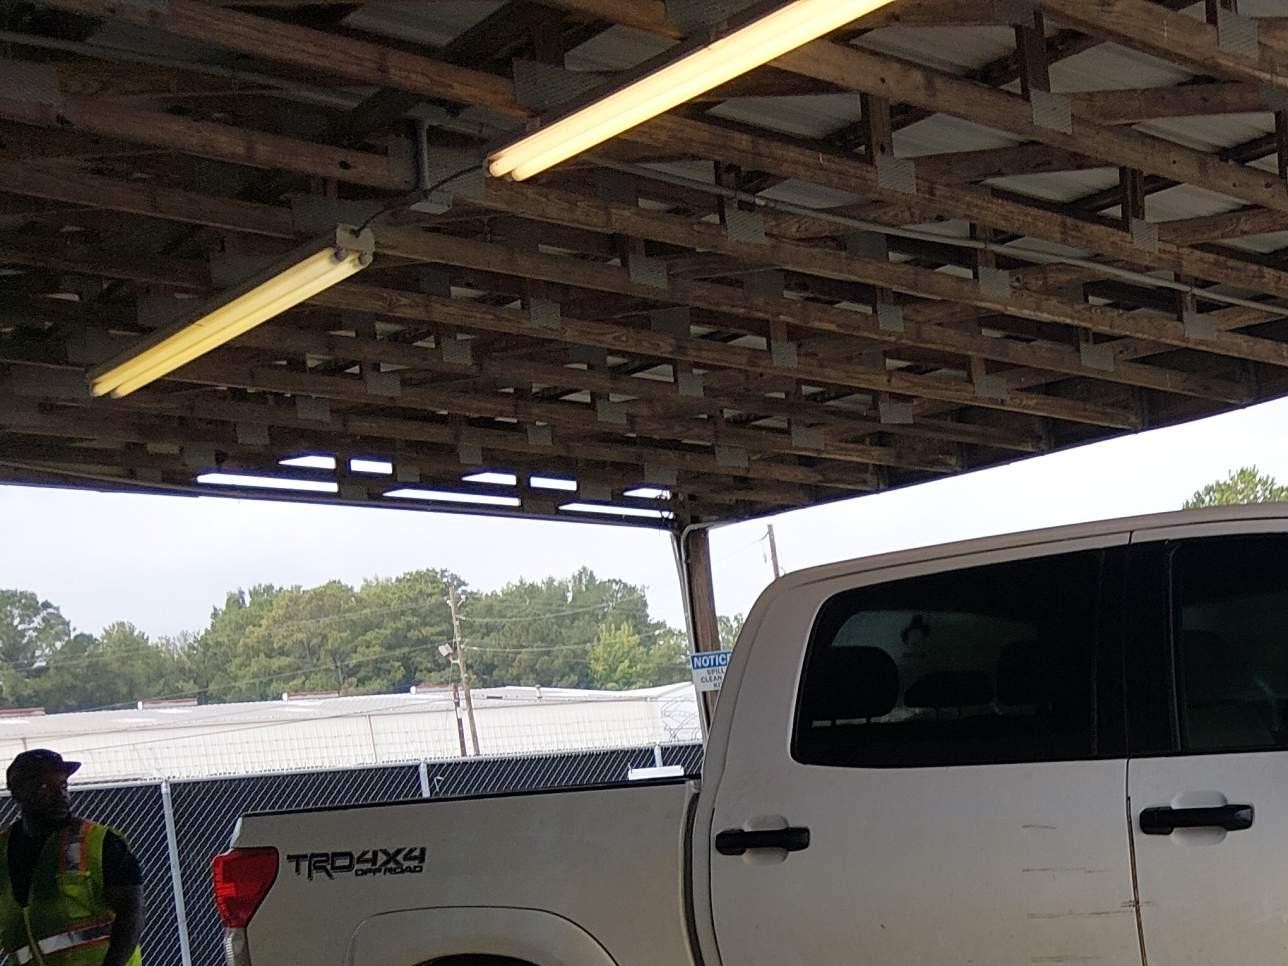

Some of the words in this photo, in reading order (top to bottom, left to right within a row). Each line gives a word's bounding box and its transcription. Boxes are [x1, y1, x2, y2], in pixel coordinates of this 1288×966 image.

[286, 851, 355, 881] TRD
[354, 866, 383, 878] OFF
[383, 864, 424, 876] ROAD
